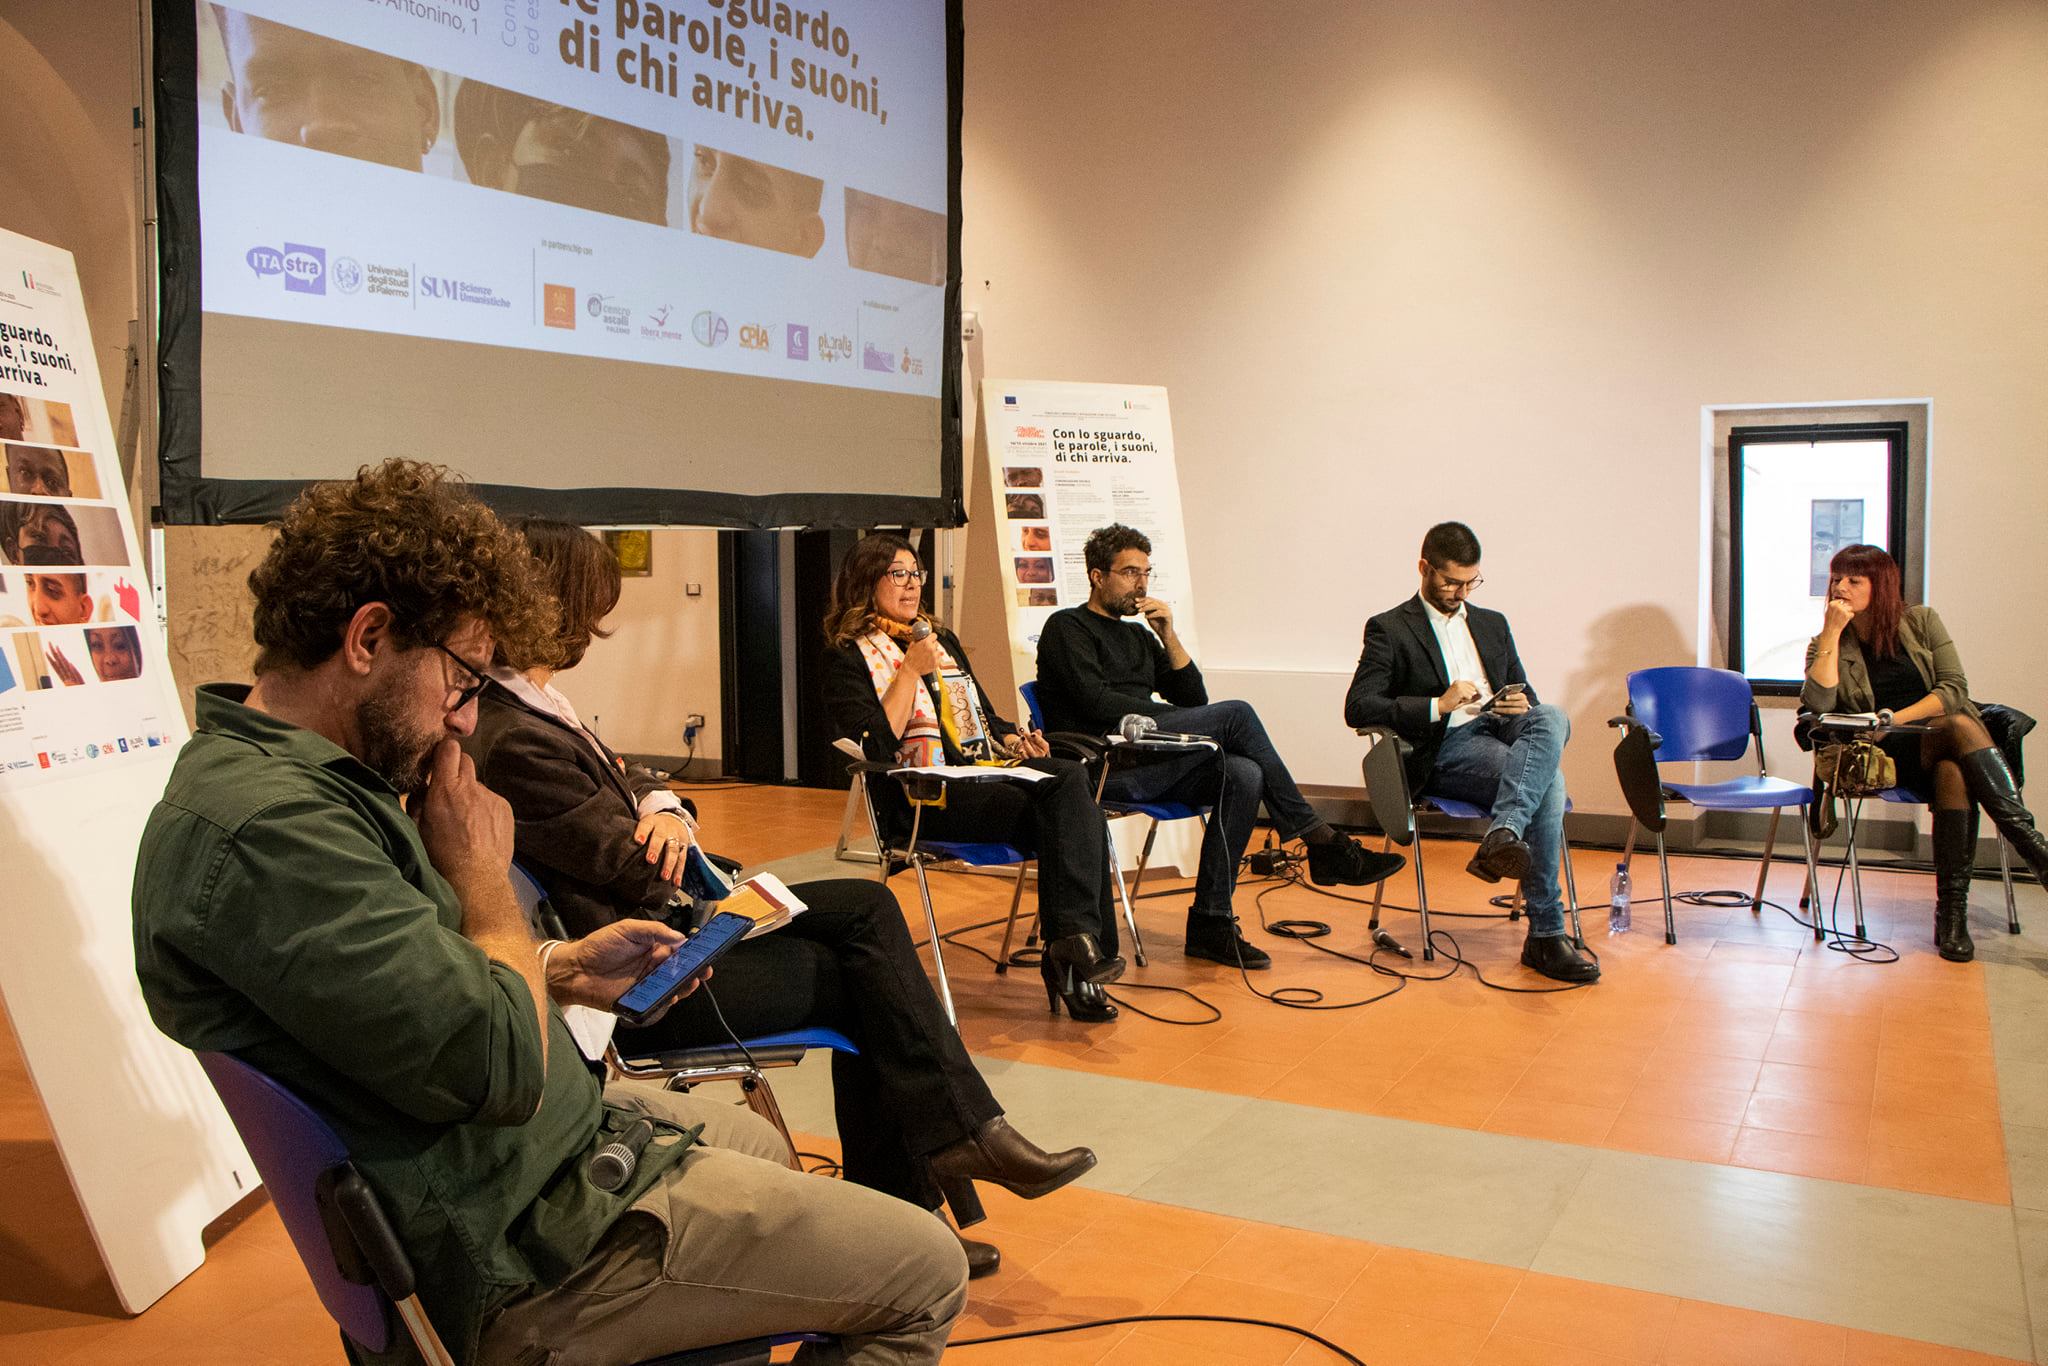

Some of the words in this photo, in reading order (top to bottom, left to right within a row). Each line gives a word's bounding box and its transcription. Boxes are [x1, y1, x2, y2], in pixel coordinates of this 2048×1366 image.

[471, 18, 478, 35] 1
[709, 0, 859, 69] guardo,
[616, 0, 756, 79] parole,
[769, 37, 778, 80] i
[791, 57, 888, 125] suoni,
[559, 18, 600, 73] di
[616, 42, 678, 98] chi
[692, 73, 814, 141] arriva.
[421, 275, 458, 301] SUM
[20, 344, 26, 362] i
[30, 350, 76, 375] suoni,
[1053, 429, 1077, 439] Con
[1079, 429, 1090, 439] lo
[1094, 430, 1145, 443] sguardo,
[1054, 440, 1065, 451] le
[1069, 441, 1111, 453] parole,
[1121, 442, 1158, 454] suoni,
[1055, 452, 1067, 462] di
[1070, 452, 1088, 463] chi
[1092, 453, 1132, 464] arriva.
